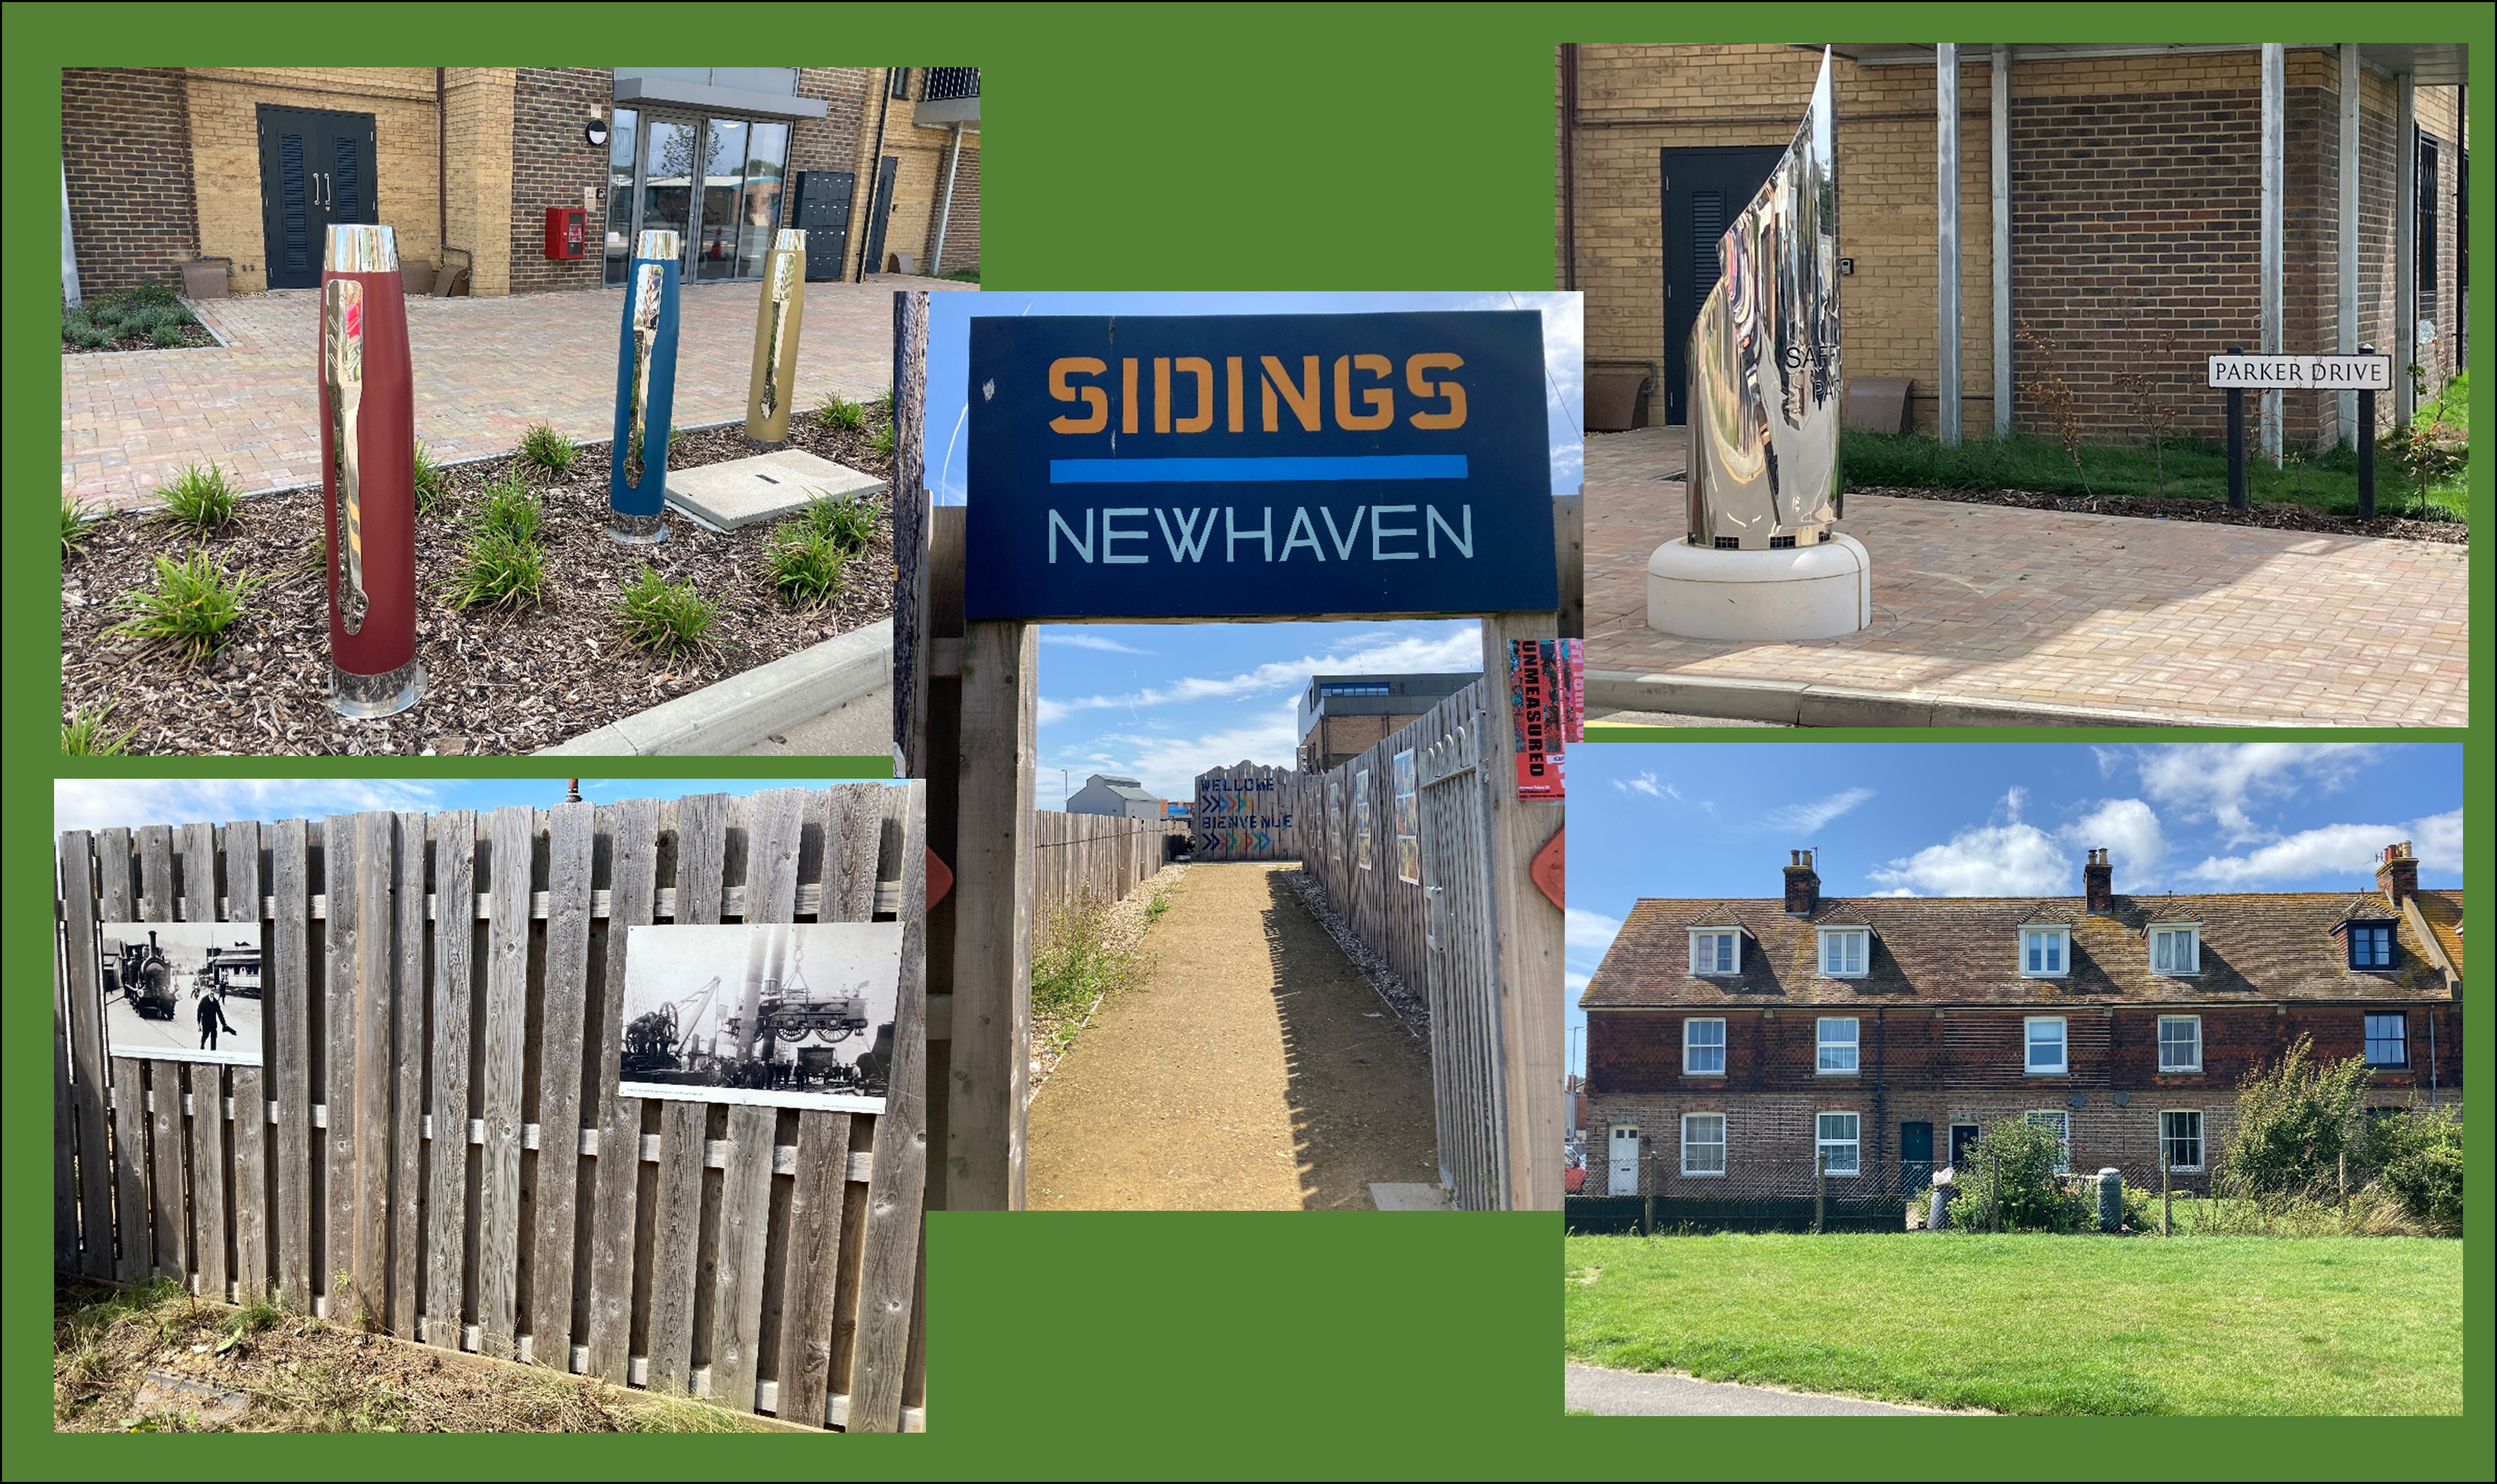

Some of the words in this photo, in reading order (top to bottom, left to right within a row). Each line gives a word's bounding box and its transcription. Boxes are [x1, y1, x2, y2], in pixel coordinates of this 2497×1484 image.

[2215, 363, 2303, 381] PARKER
[2311, 363, 2382, 381] DRIVE
[1049, 352, 1468, 435] SIDINGS
[1048, 504, 1474, 564] NEWHAVEN
[1522, 639, 1545, 777] UNMEASURED
[1201, 777, 1275, 792] WELCOME
[1201, 814, 1293, 829] BIENVENUE
